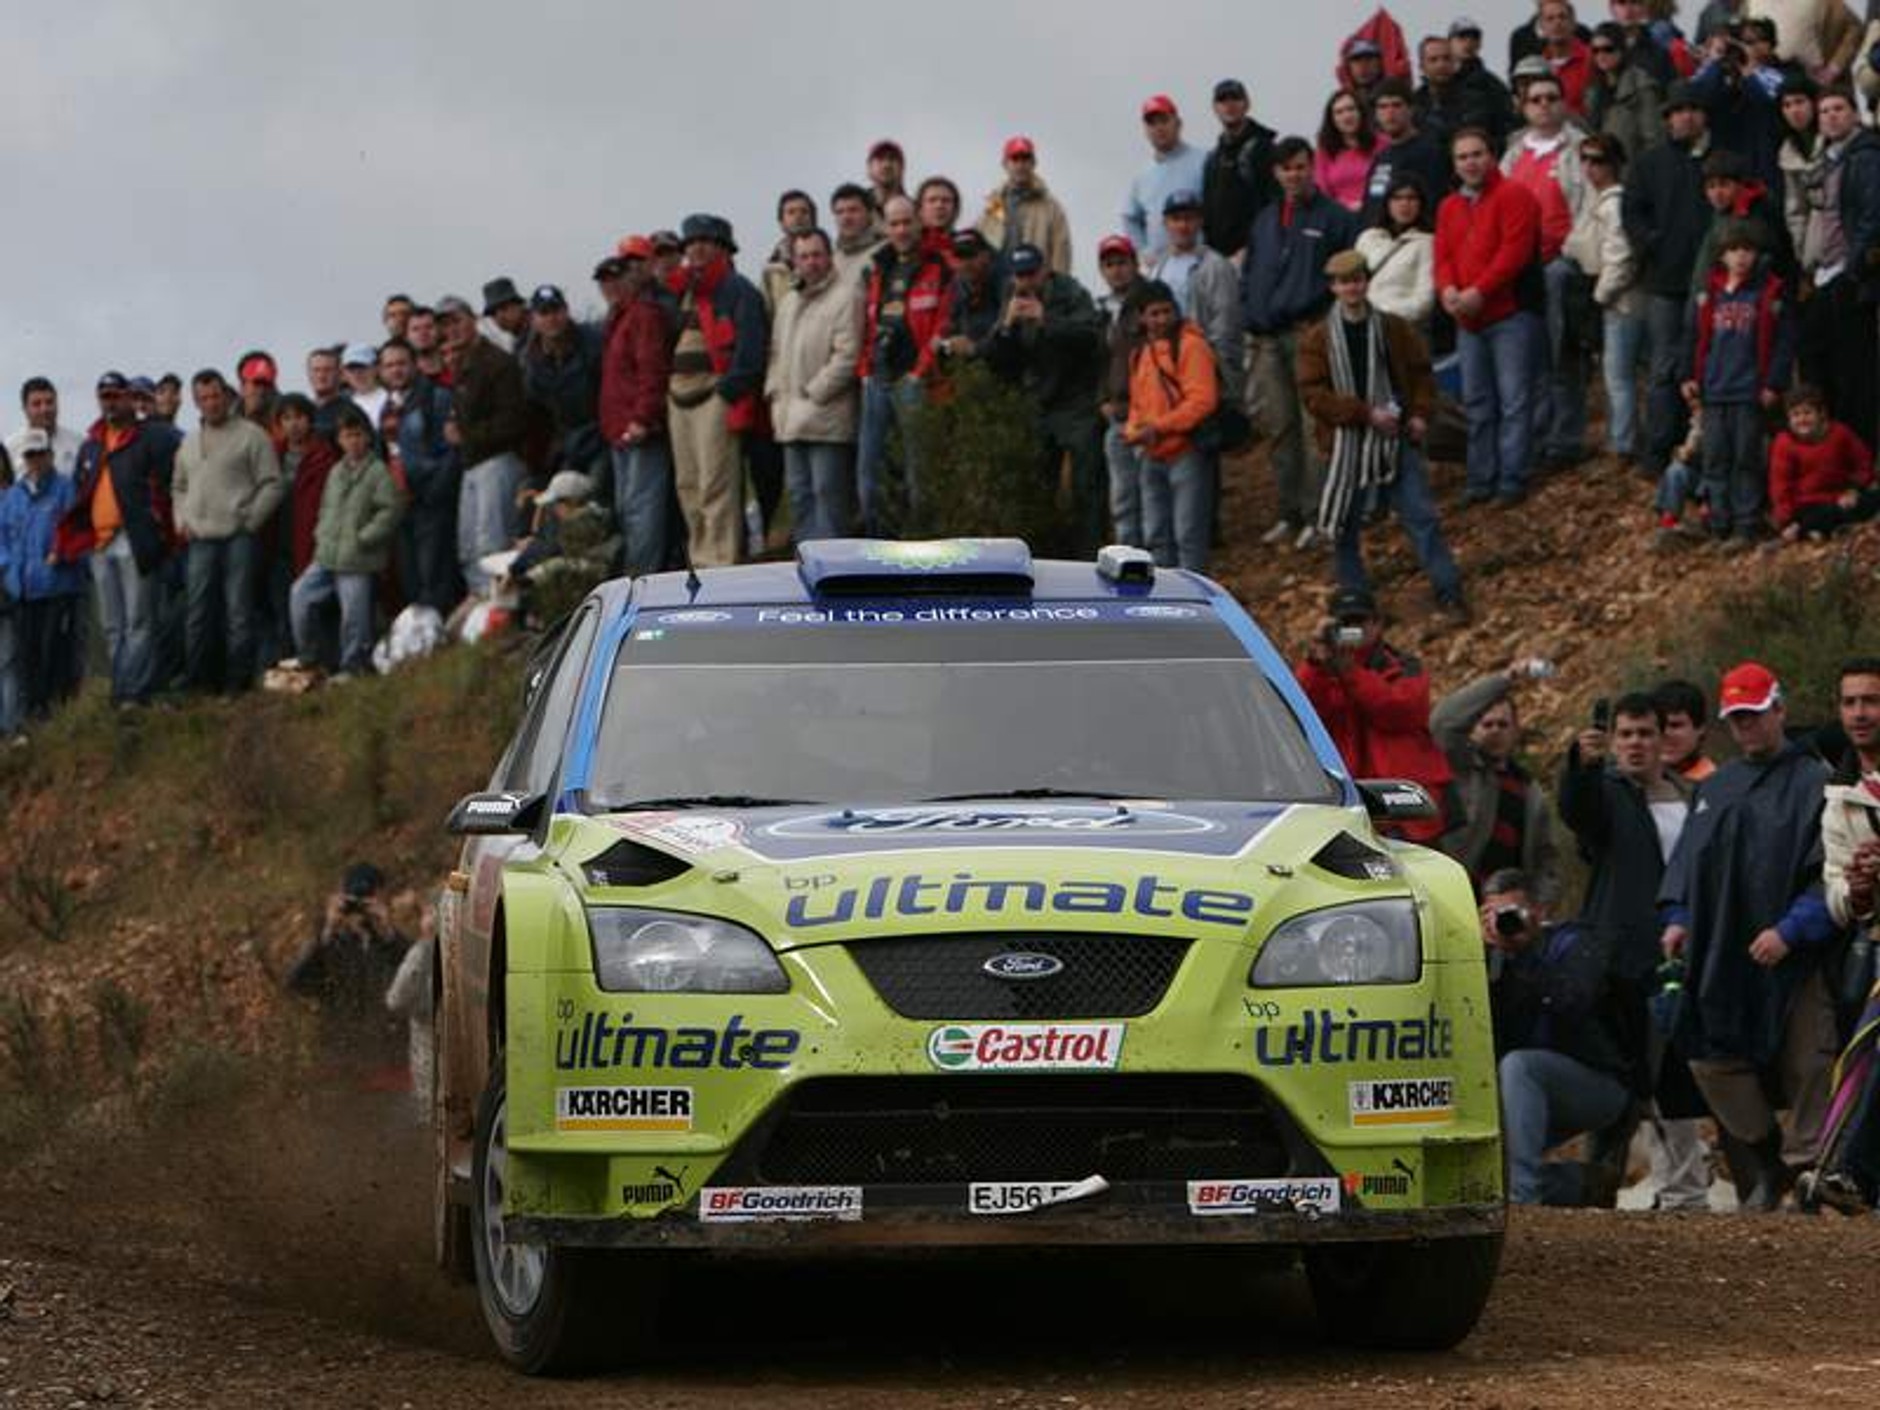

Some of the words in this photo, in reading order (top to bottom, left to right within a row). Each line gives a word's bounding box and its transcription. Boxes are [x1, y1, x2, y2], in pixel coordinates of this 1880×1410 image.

[758, 609, 833, 622] Feel
[847, 609, 904, 622] the
[915, 608, 1099, 622] difference
[785, 875, 838, 891] bp
[785, 874, 1255, 928] ultimate
[1243, 997, 1281, 1022] bp
[556, 1012, 800, 1070] ultimate
[976, 1028, 1110, 1063] Castrol
[568, 1090, 691, 1116] KÄRCHER
[622, 1184, 674, 1205] PUMA
[1363, 1176, 1409, 1195] PUMA
[709, 1191, 852, 1210] BFGoodrich
